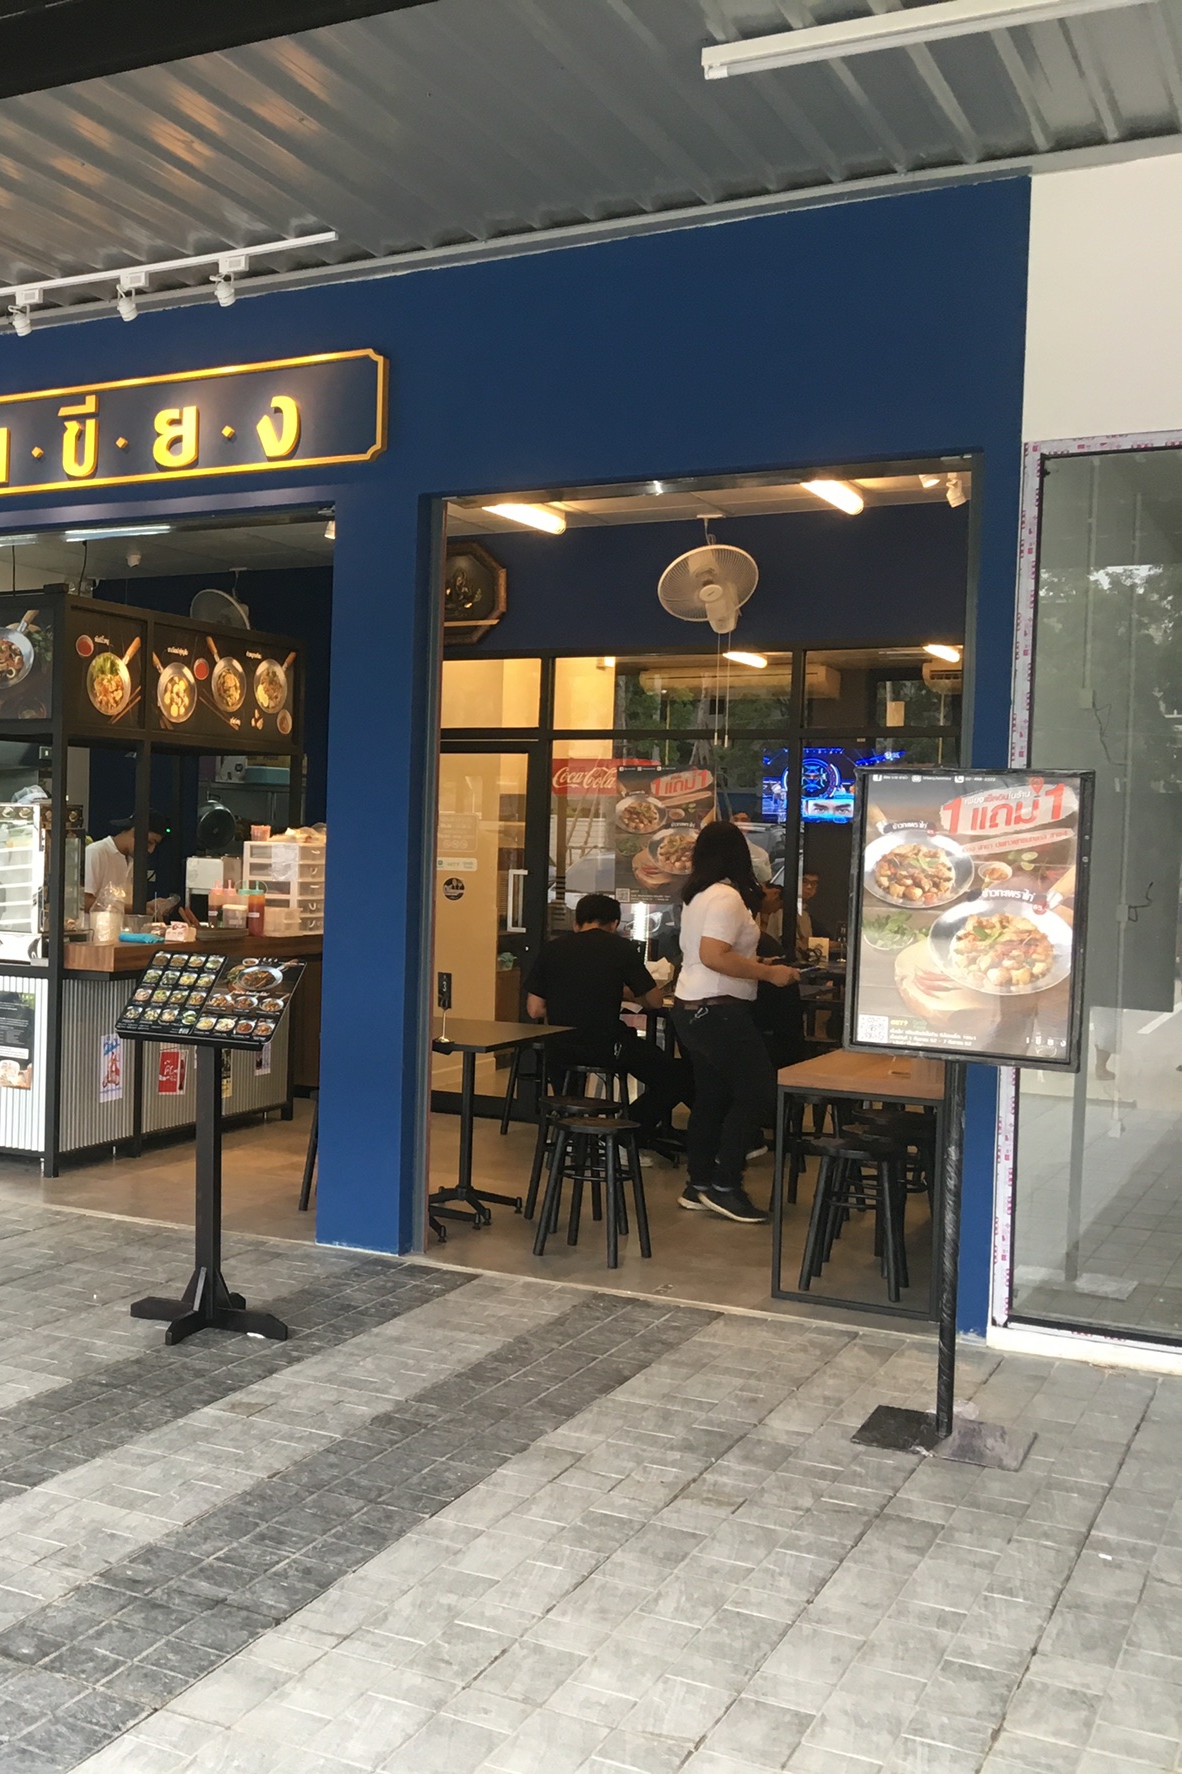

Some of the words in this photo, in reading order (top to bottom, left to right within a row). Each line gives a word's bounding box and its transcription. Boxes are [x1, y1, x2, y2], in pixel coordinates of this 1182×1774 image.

[552, 766, 617, 789] Coca-Cola
[942, 797, 962, 834] 1
[971, 798, 1040, 831] แถม
[1045, 783, 1065, 820] 1
